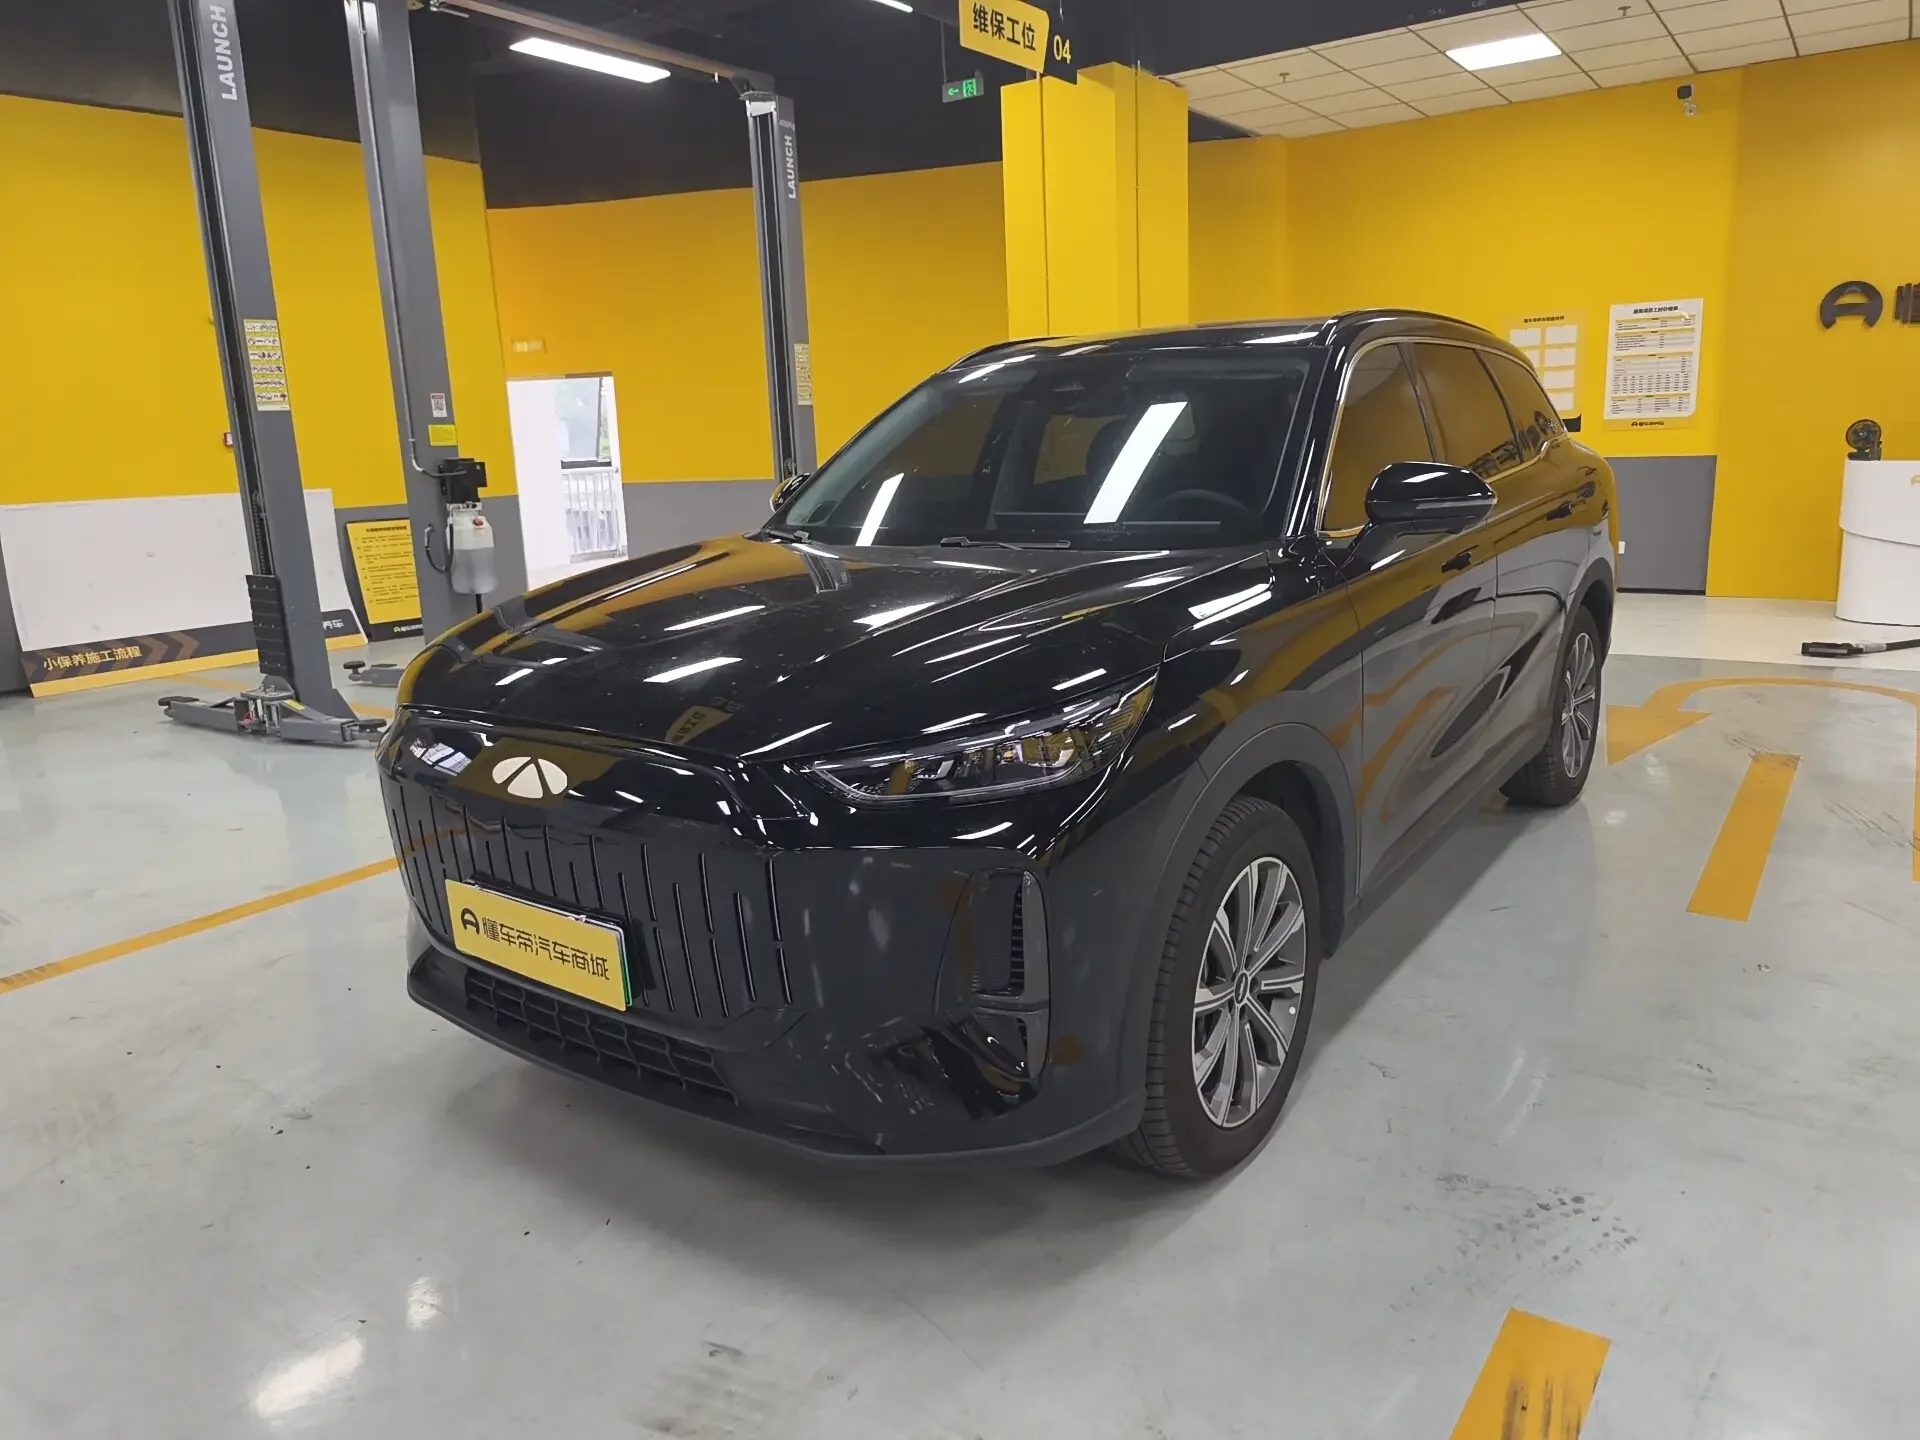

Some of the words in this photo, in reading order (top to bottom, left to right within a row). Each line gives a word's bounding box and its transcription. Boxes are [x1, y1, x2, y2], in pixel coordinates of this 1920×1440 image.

[209, 5, 238, 101] LAUNCH
[972, 2, 1036, 52] 维保工位
[1053, 34, 1071, 64] 04
[784, 135, 796, 199] LAUNCH
[43, 645, 143, 671] 小保养施工流程
[481, 916, 611, 981] 懂车帝汽车商城
